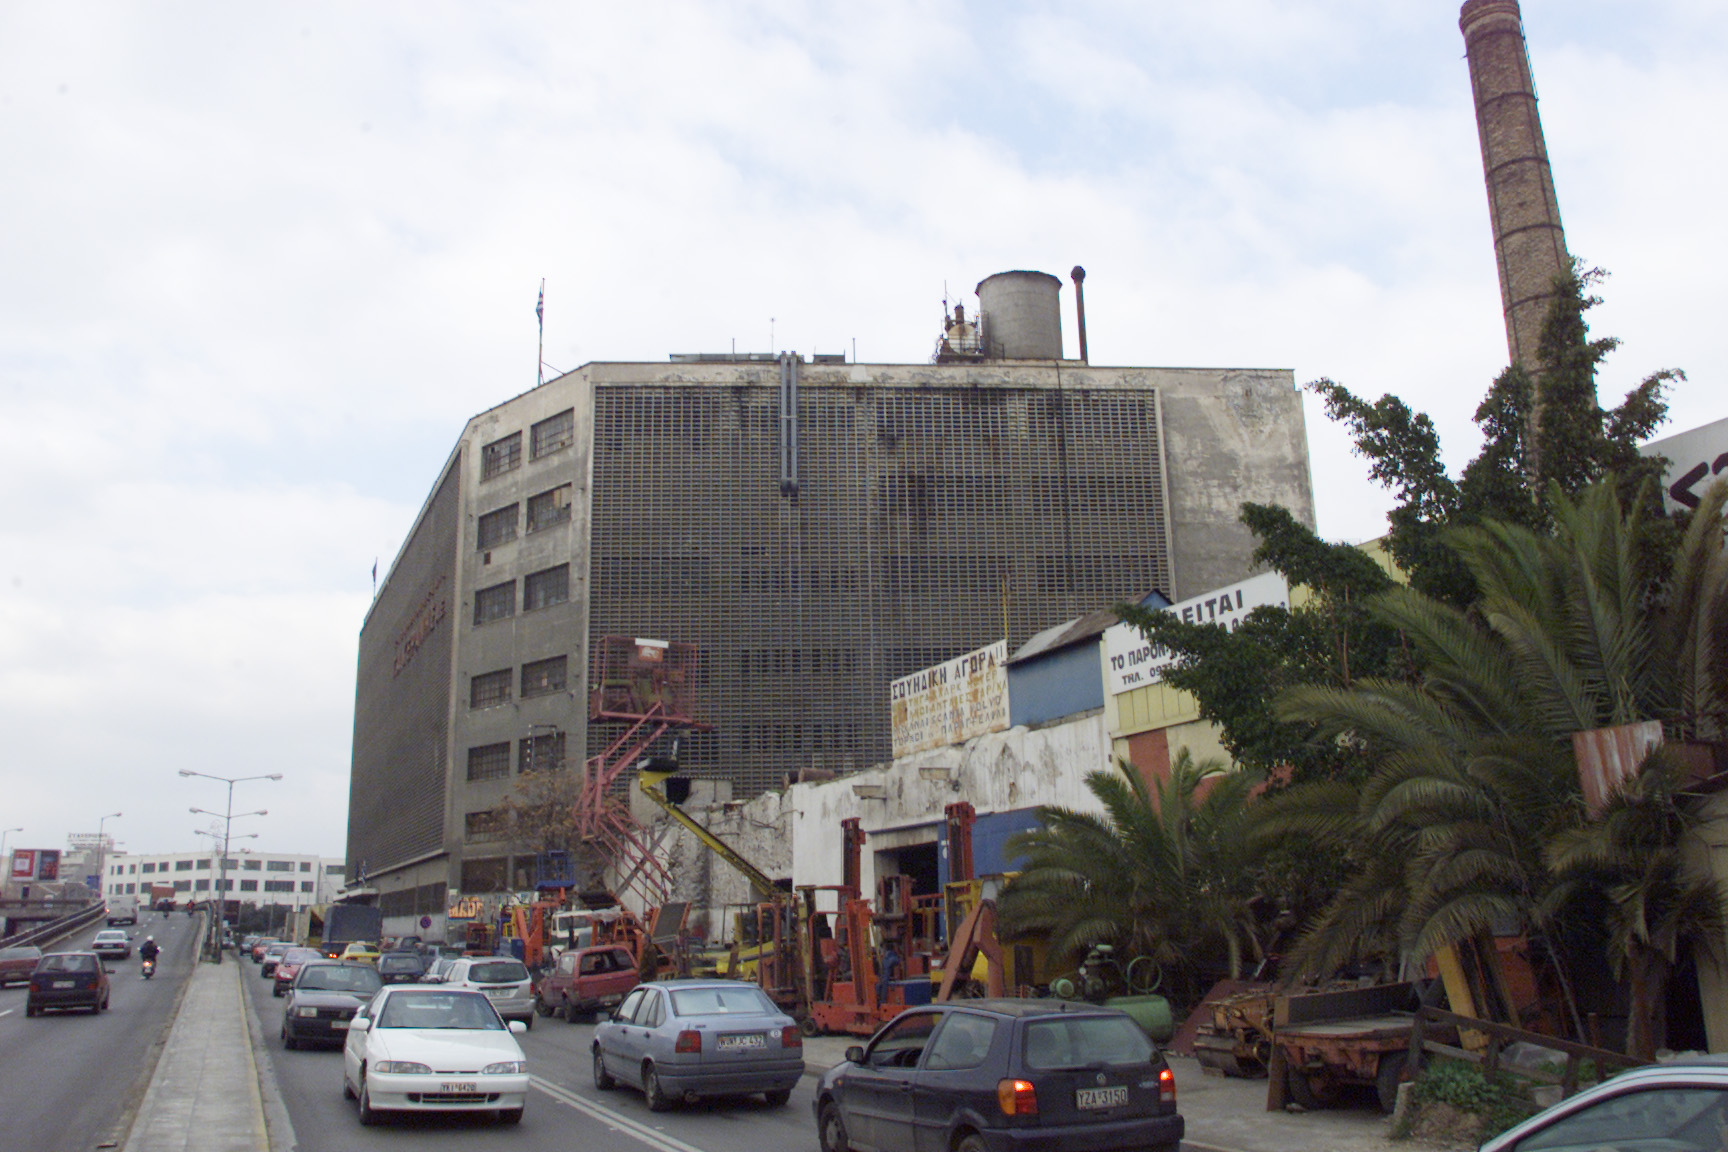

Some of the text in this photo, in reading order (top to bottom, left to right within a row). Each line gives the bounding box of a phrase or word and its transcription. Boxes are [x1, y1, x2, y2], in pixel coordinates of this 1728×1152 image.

[1110, 654, 1125, 671] ΤΟ
[892, 667, 947, 700] ΣΟΥΗΔΙΚΗ
[1122, 671, 1144, 685] ΤΗΛ.
[1102, 1088, 1127, 1104] 3150
